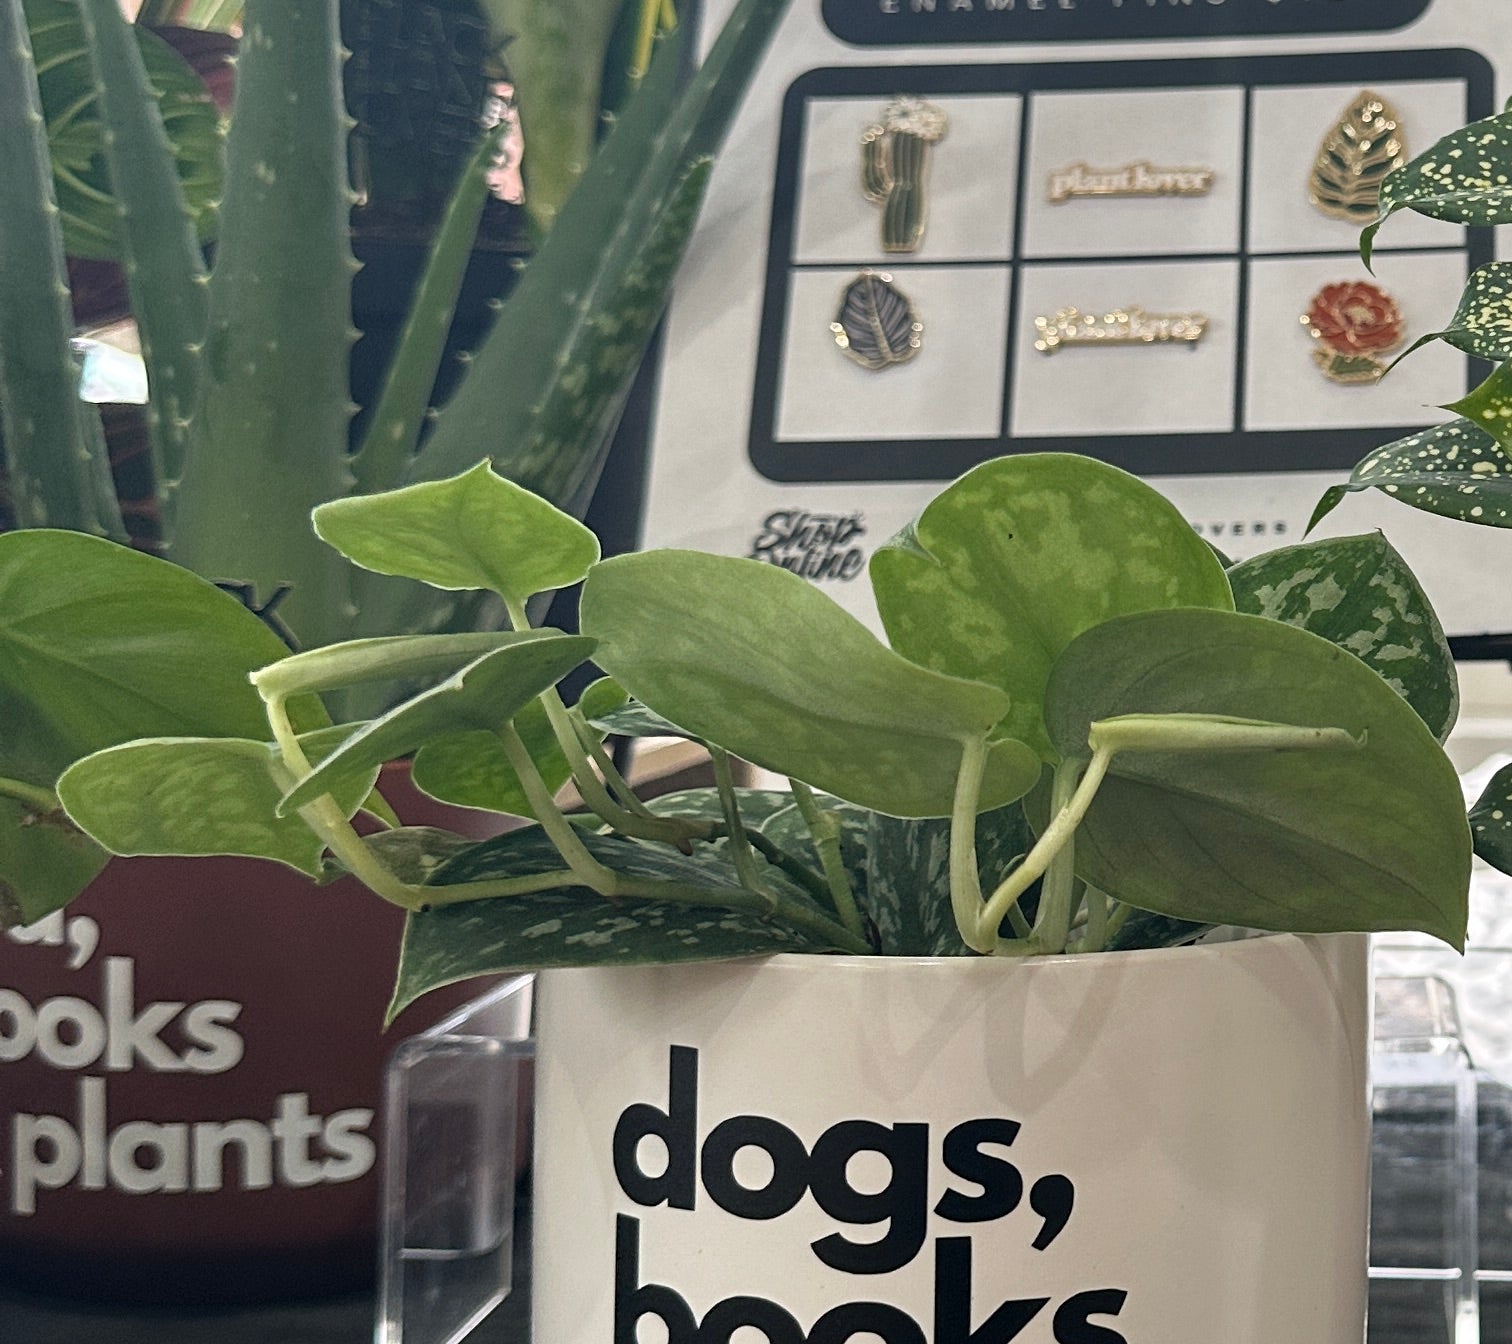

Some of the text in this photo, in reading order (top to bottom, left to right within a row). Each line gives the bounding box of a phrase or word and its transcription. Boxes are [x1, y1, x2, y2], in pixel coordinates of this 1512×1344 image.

[753, 511, 868, 553] Shop
[0, 956, 245, 1075] ooks
[11, 1075, 377, 1217] plants
[612, 1044, 1075, 1276] dogs,
